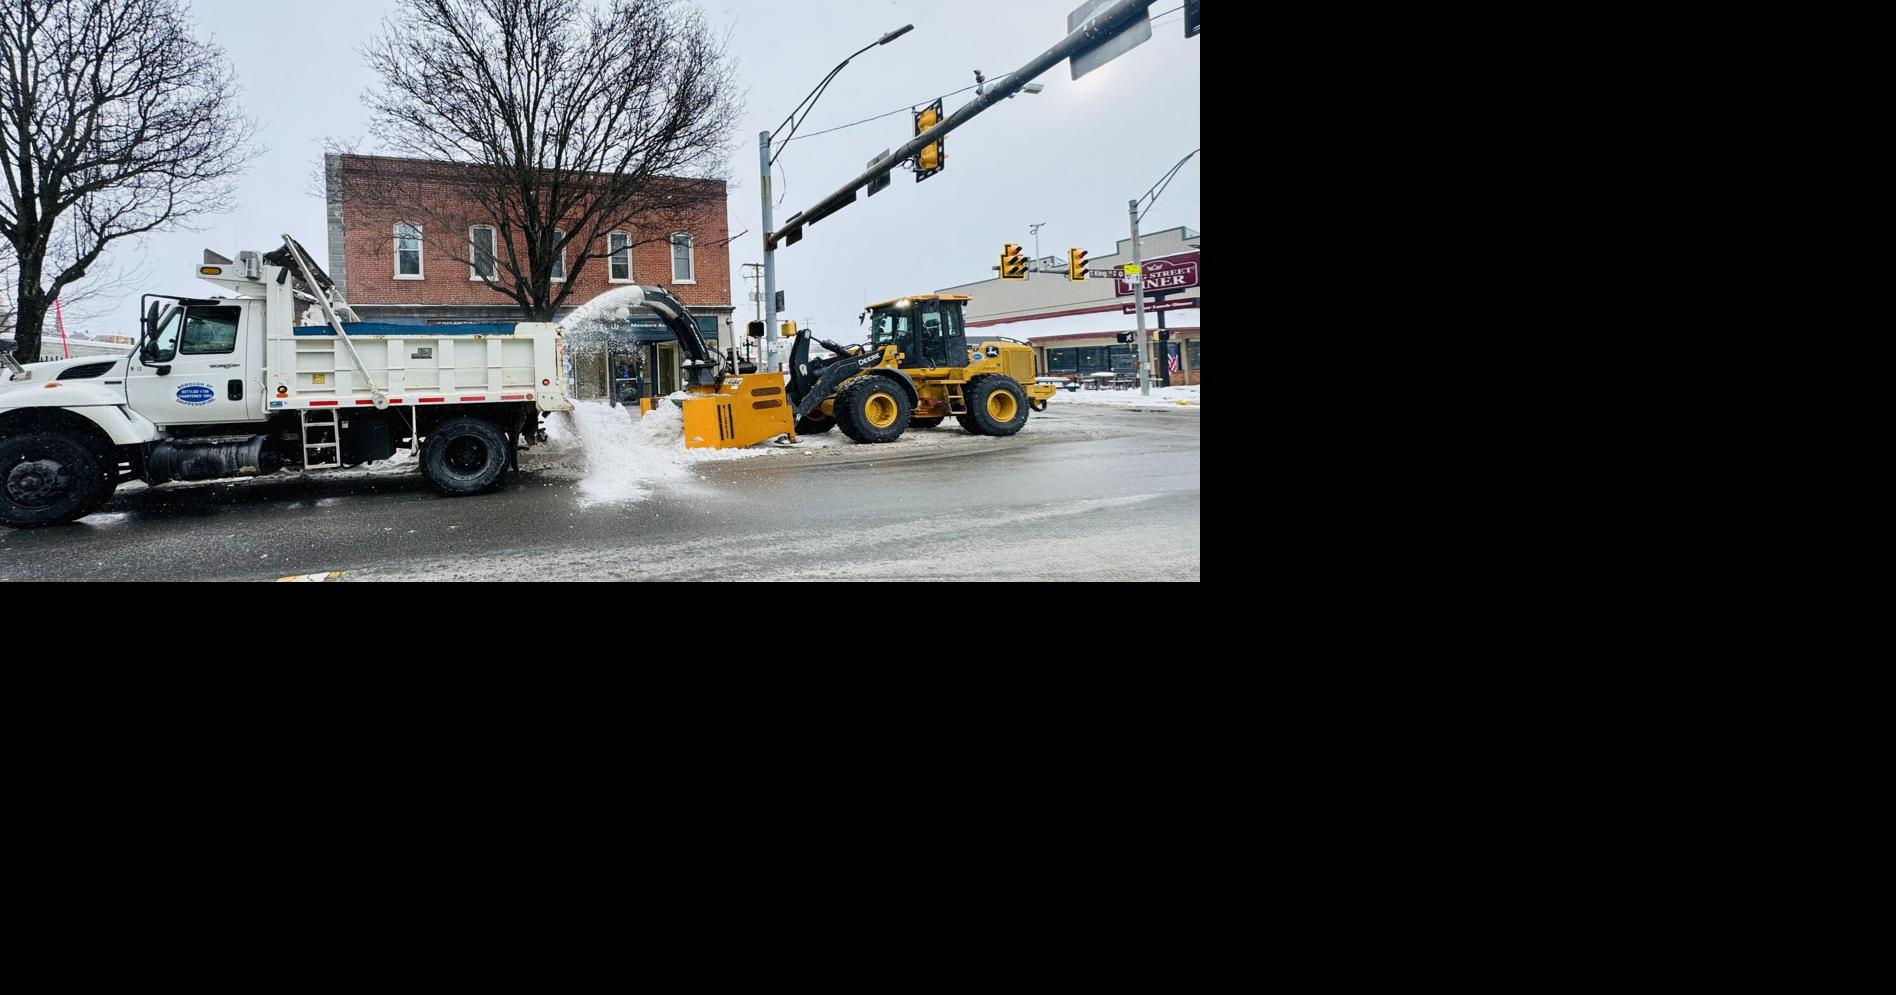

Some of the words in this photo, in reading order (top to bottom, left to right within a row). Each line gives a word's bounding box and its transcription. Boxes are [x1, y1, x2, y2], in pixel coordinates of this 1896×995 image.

[1094, 270, 1107, 278] King
[1150, 266, 1194, 279] STREET
[858, 352, 881, 366] DEERE
